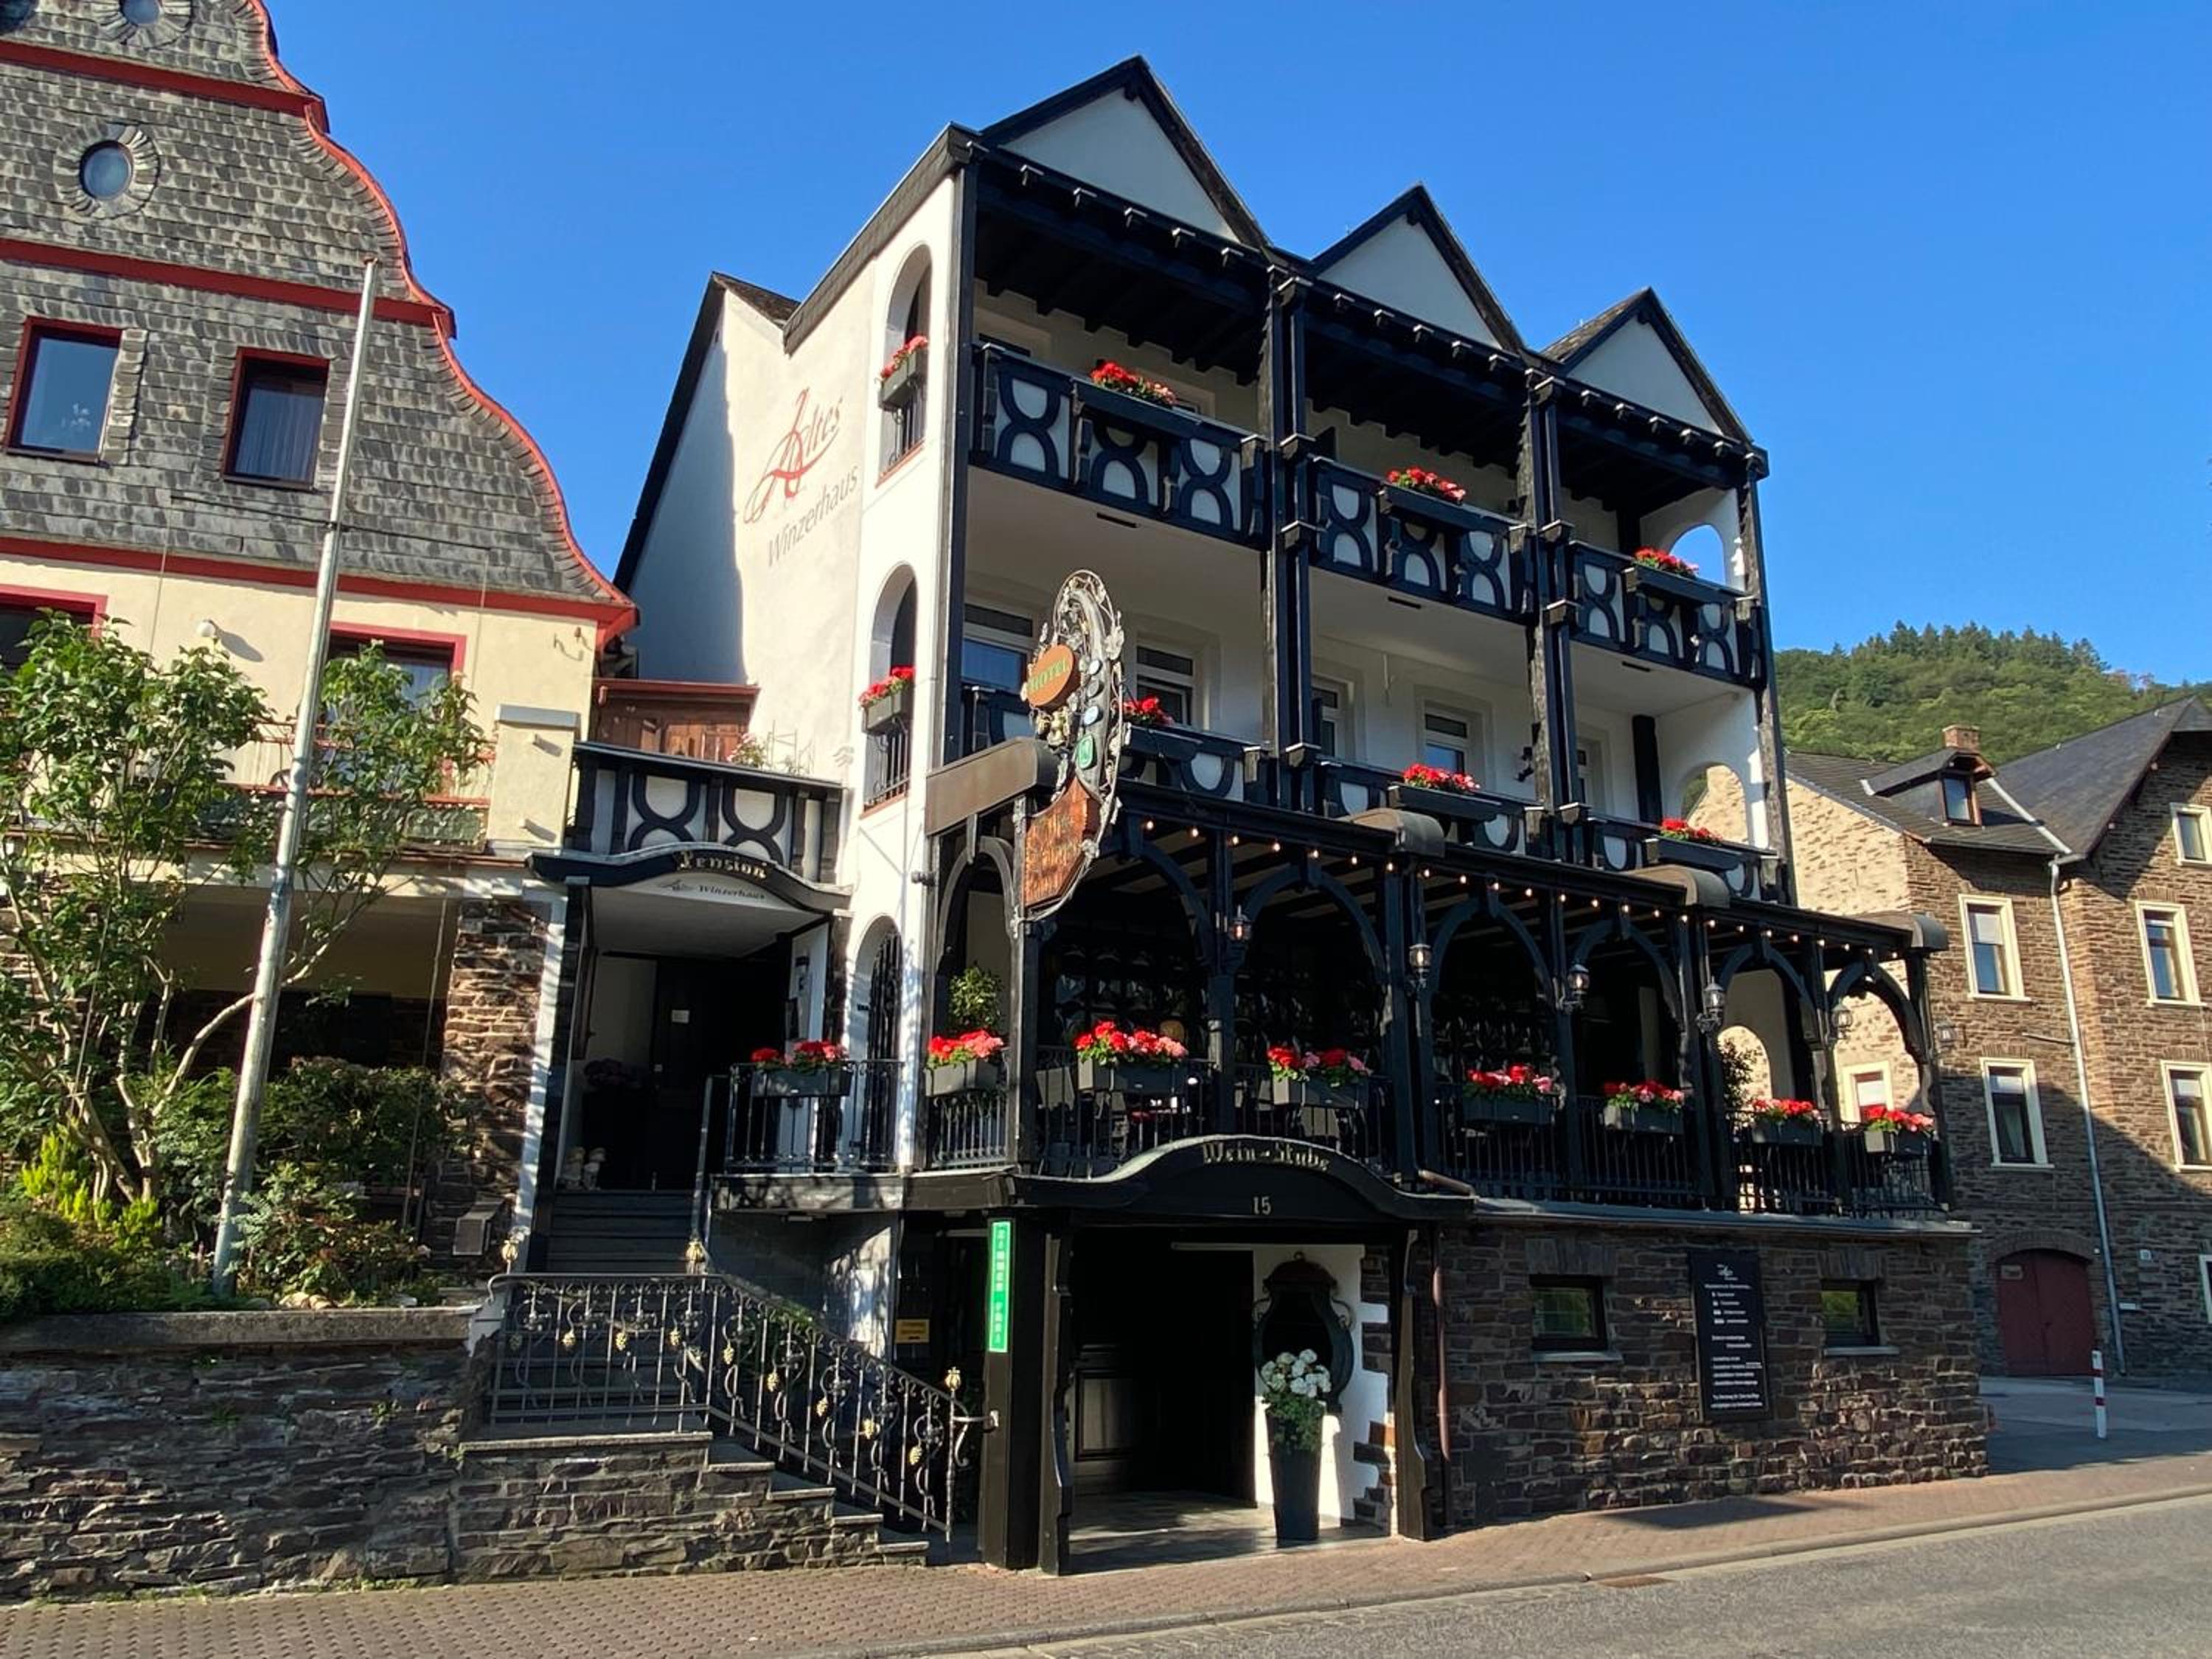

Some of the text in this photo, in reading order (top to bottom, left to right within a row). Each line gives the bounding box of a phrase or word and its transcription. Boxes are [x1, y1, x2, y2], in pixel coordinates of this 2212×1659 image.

[743, 386, 844, 524] Altes
[768, 465, 858, 567] Winzerhaus
[678, 850, 766, 878] Pension
[1253, 1196, 1272, 1215] 15
